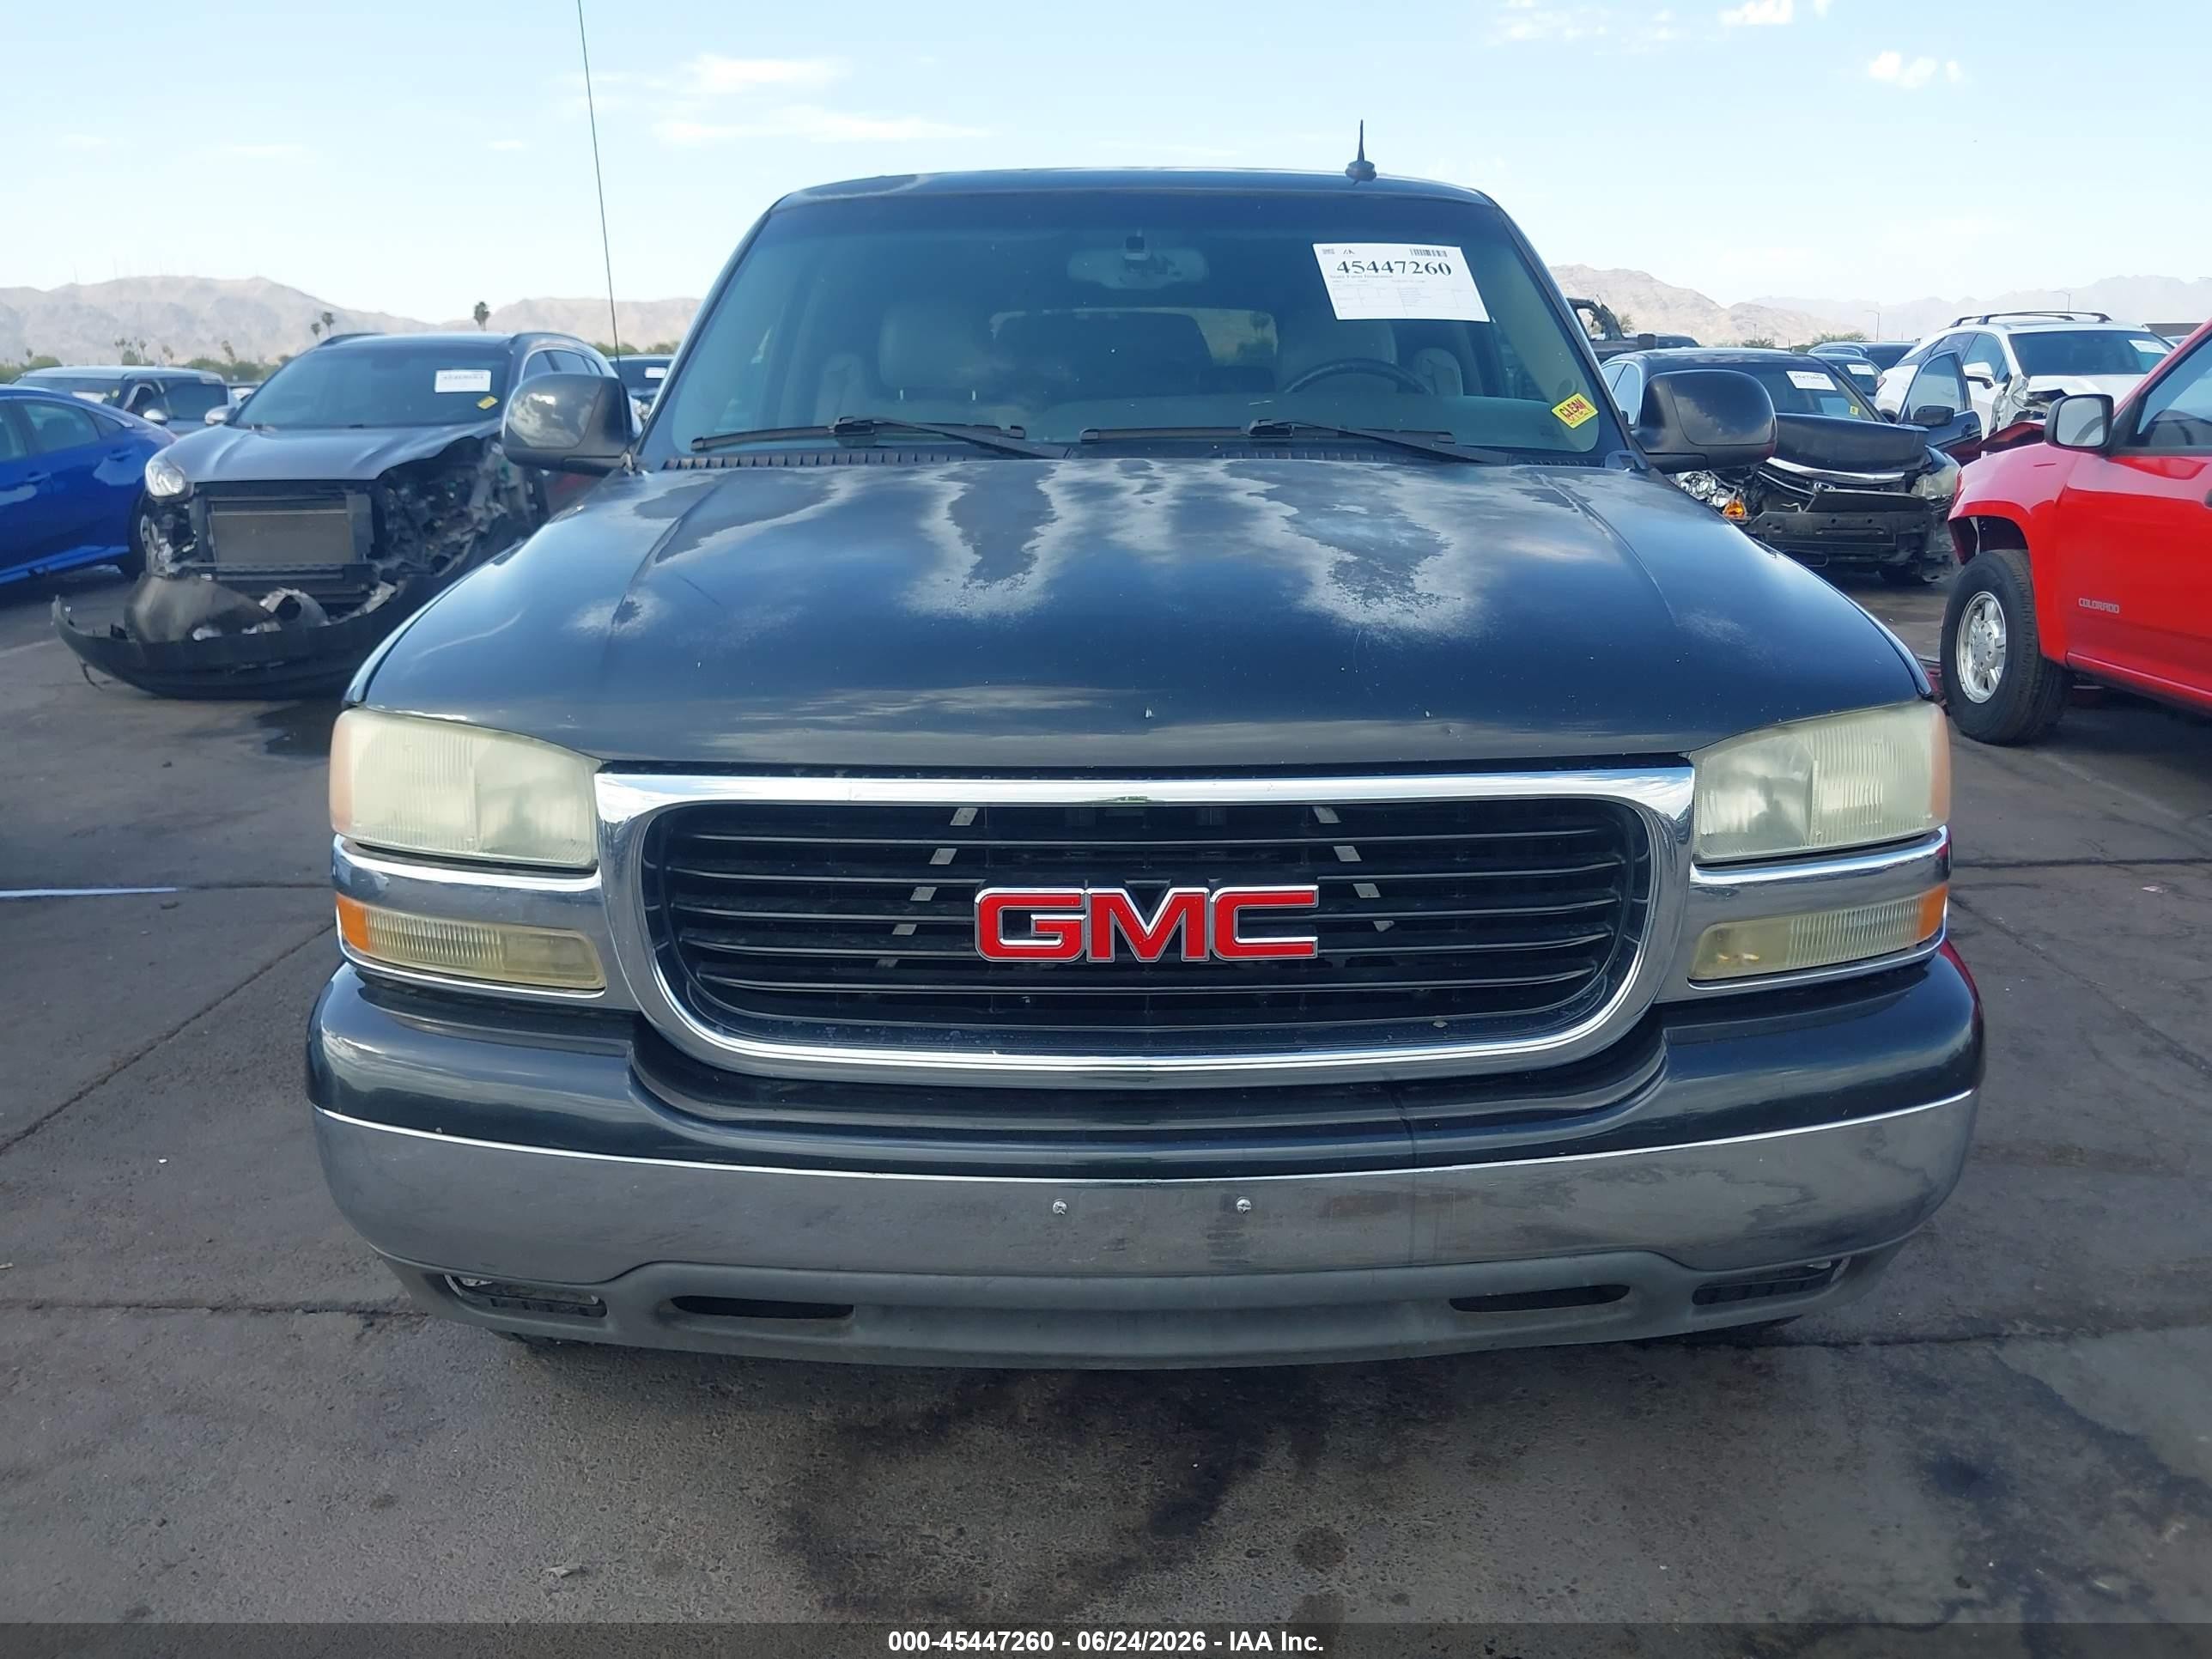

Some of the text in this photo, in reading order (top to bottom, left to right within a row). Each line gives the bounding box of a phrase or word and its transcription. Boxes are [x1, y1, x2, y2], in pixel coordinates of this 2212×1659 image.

[1337, 260, 1452, 276] 45447260
[2078, 597, 2120, 614] COLORADO
[974, 884, 1319, 963] GMC
